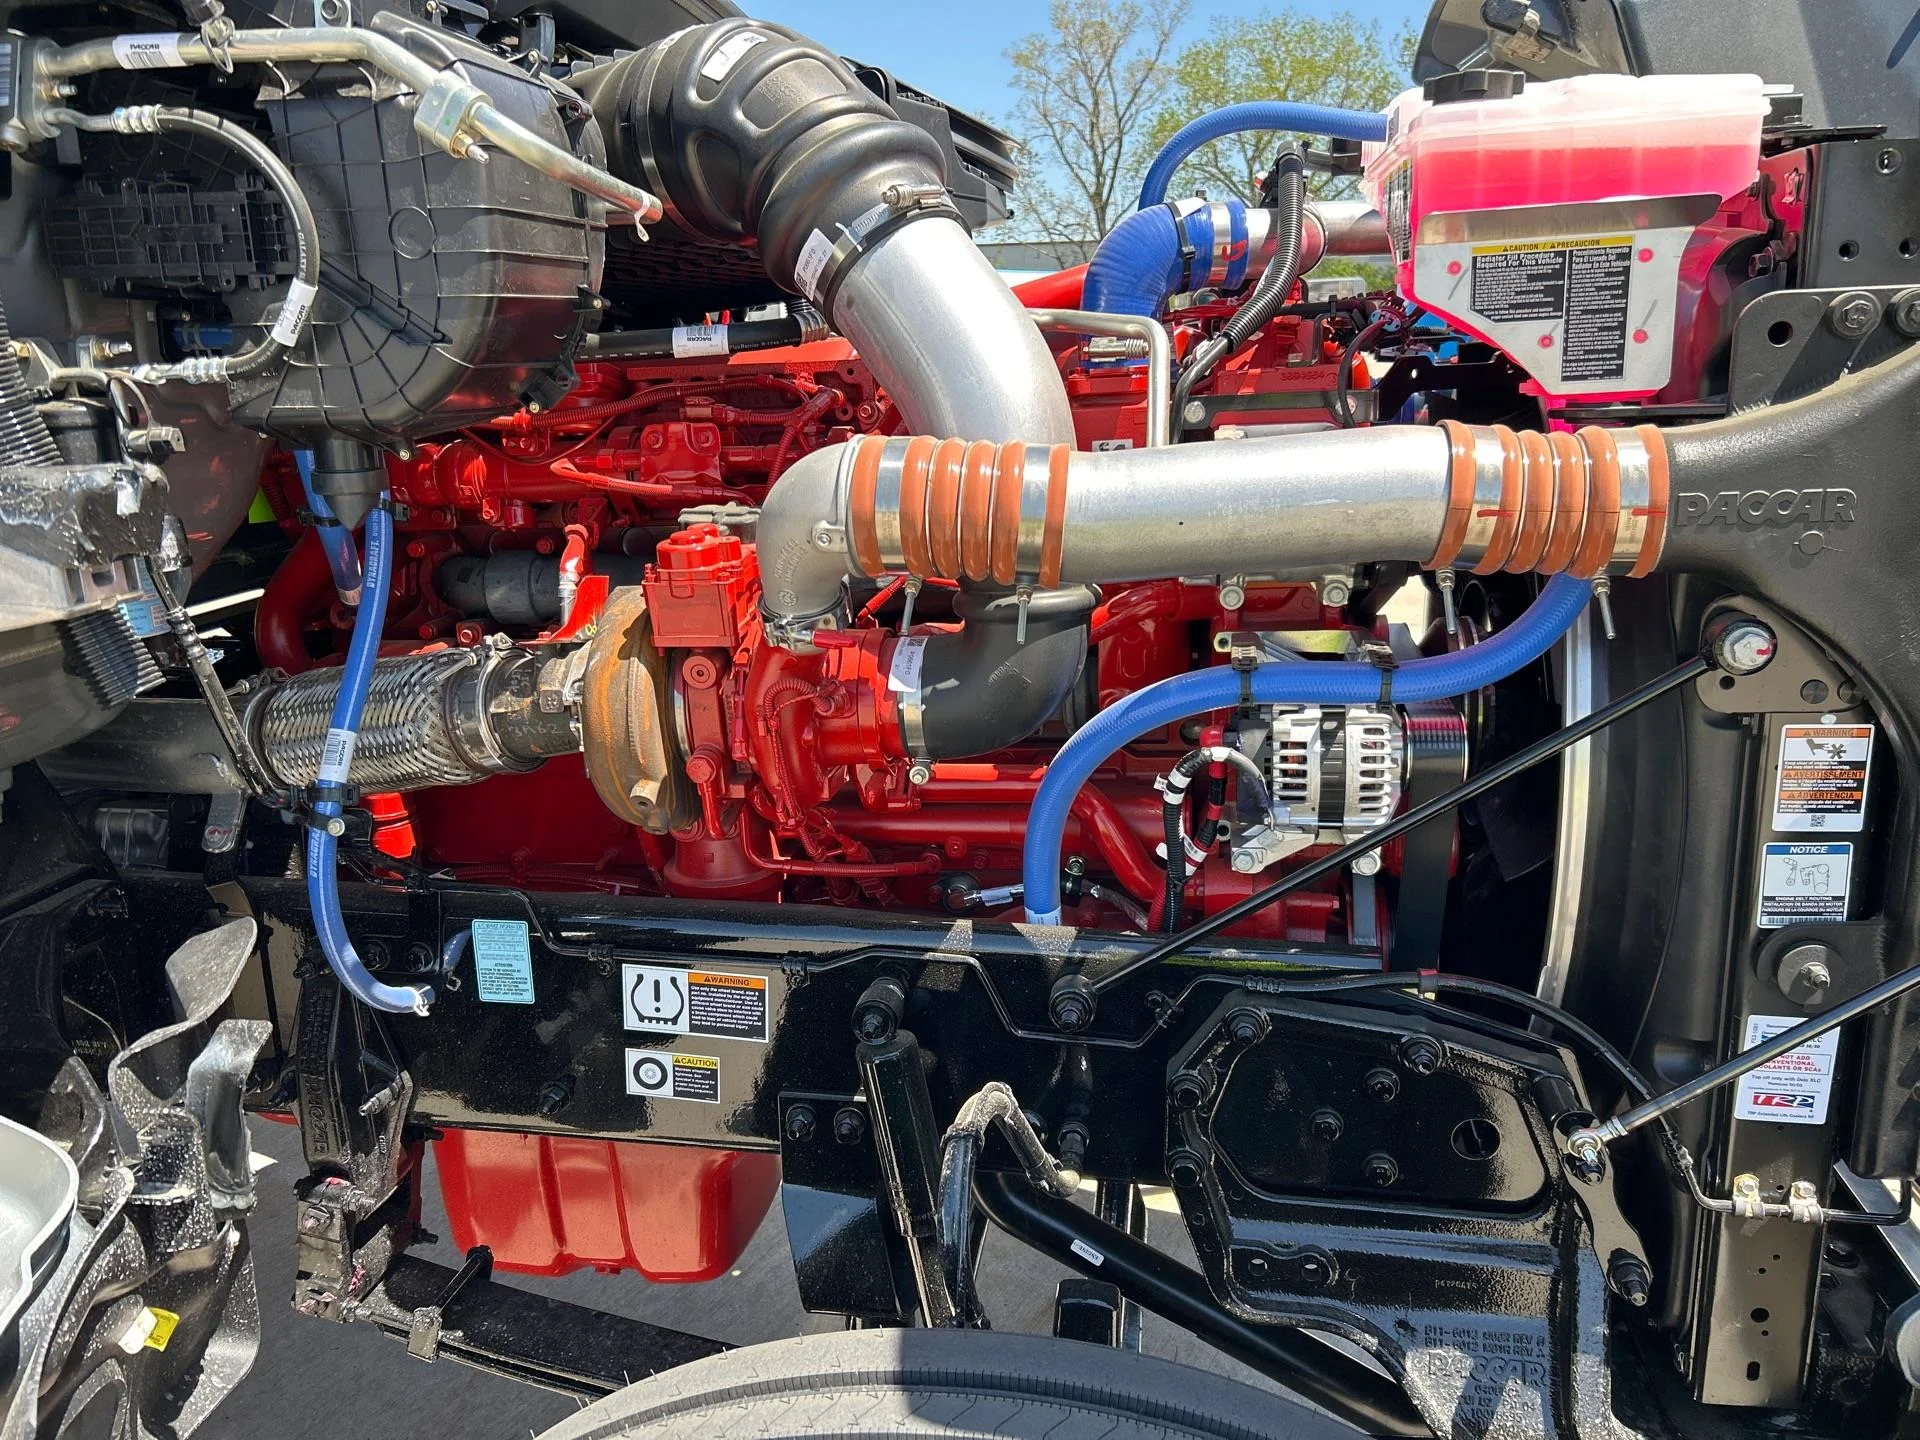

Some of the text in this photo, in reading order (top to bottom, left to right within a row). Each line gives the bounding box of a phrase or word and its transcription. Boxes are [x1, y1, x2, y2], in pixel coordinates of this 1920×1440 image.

[1509, 242, 1538, 251] CAUTION
[1557, 239, 1600, 249] PRECAUCION
[1477, 254, 1505, 262] Radiator
[290, 304, 306, 336] PACCAR
[1678, 488, 1857, 526] PACCAR
[1813, 729, 1854, 737] WARNING
[711, 976, 750, 986] WARNING
[681, 1058, 717, 1067] CAUTION
[1757, 1094, 1814, 1108] TRP
[1428, 1350, 1547, 1387] PACCAR
